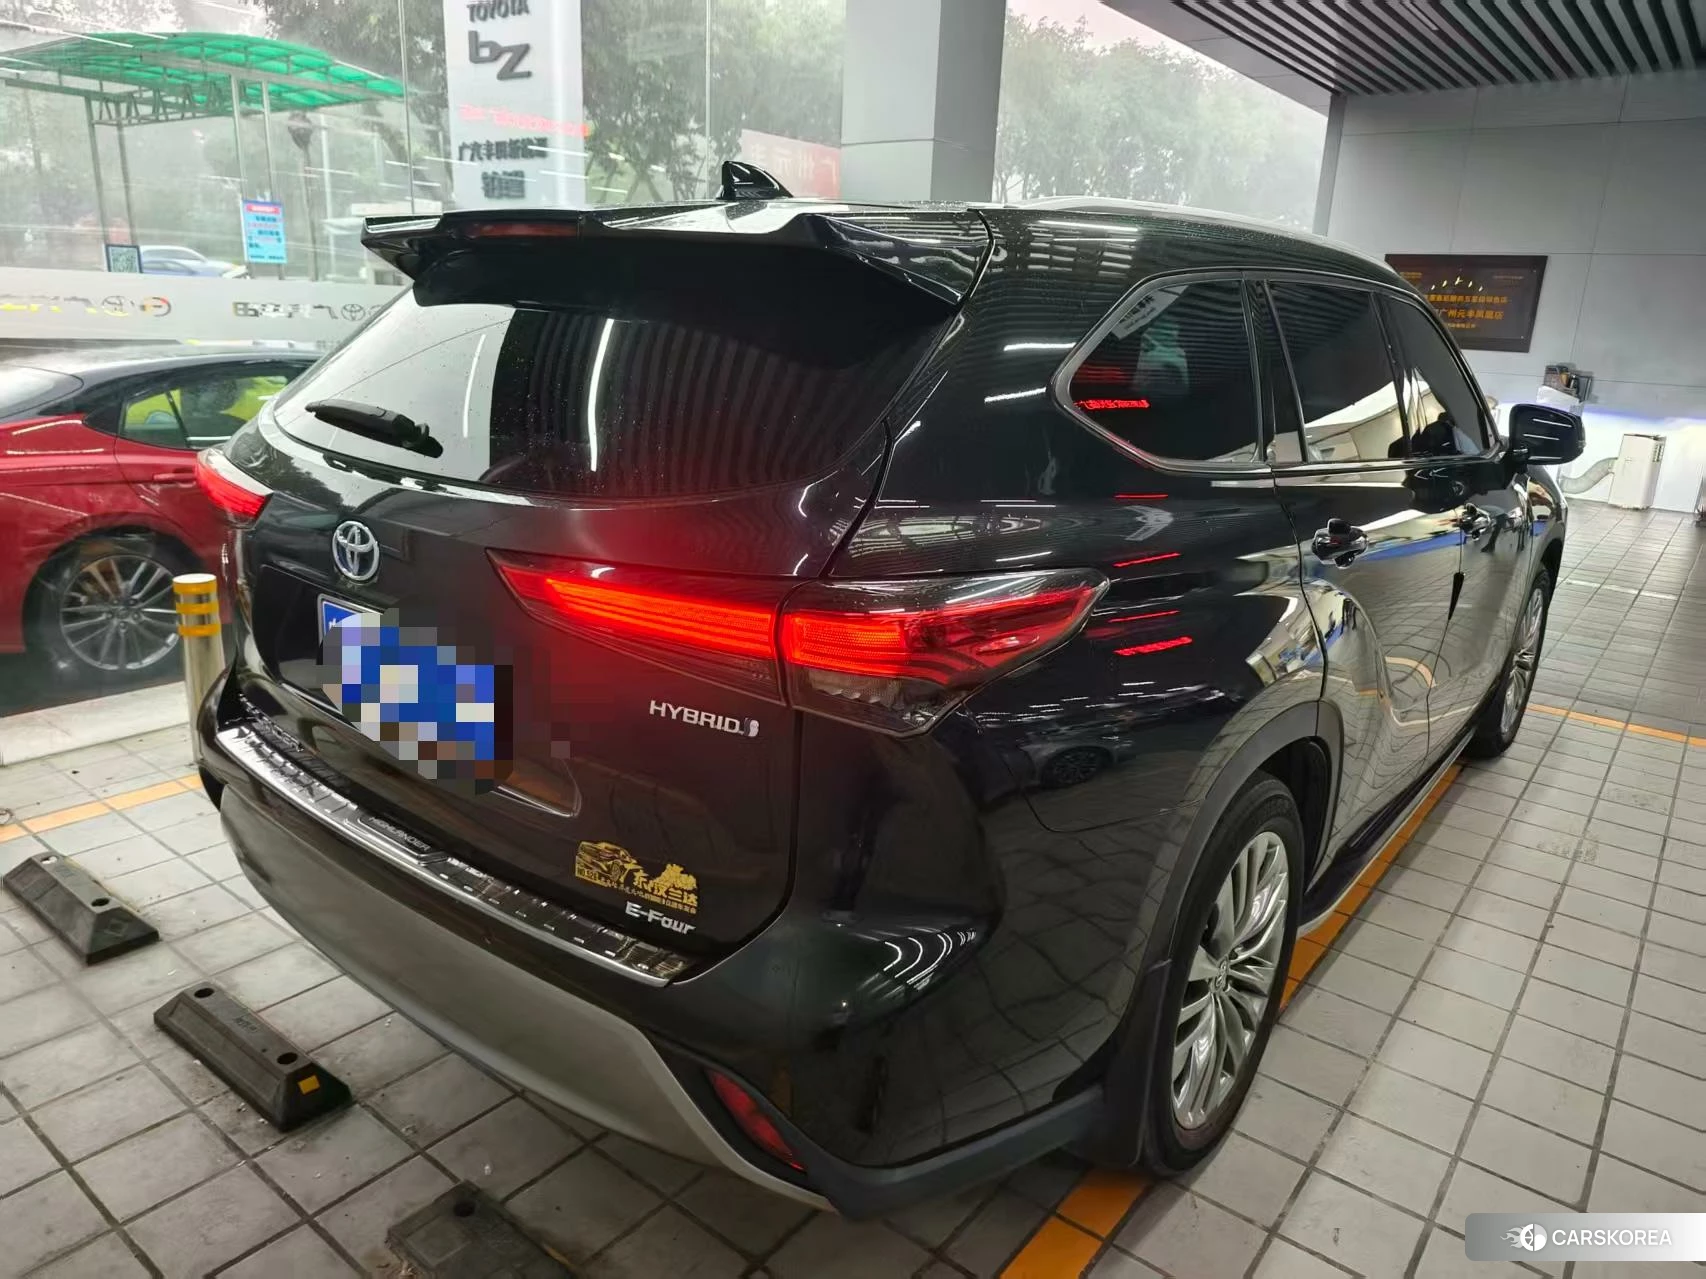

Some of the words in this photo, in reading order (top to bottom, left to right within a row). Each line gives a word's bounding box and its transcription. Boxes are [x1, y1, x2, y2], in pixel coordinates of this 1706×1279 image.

[466, 0, 529, 22] TOYOTA
[649, 700, 741, 734] HYBRID
[625, 901, 697, 934] E-Four
